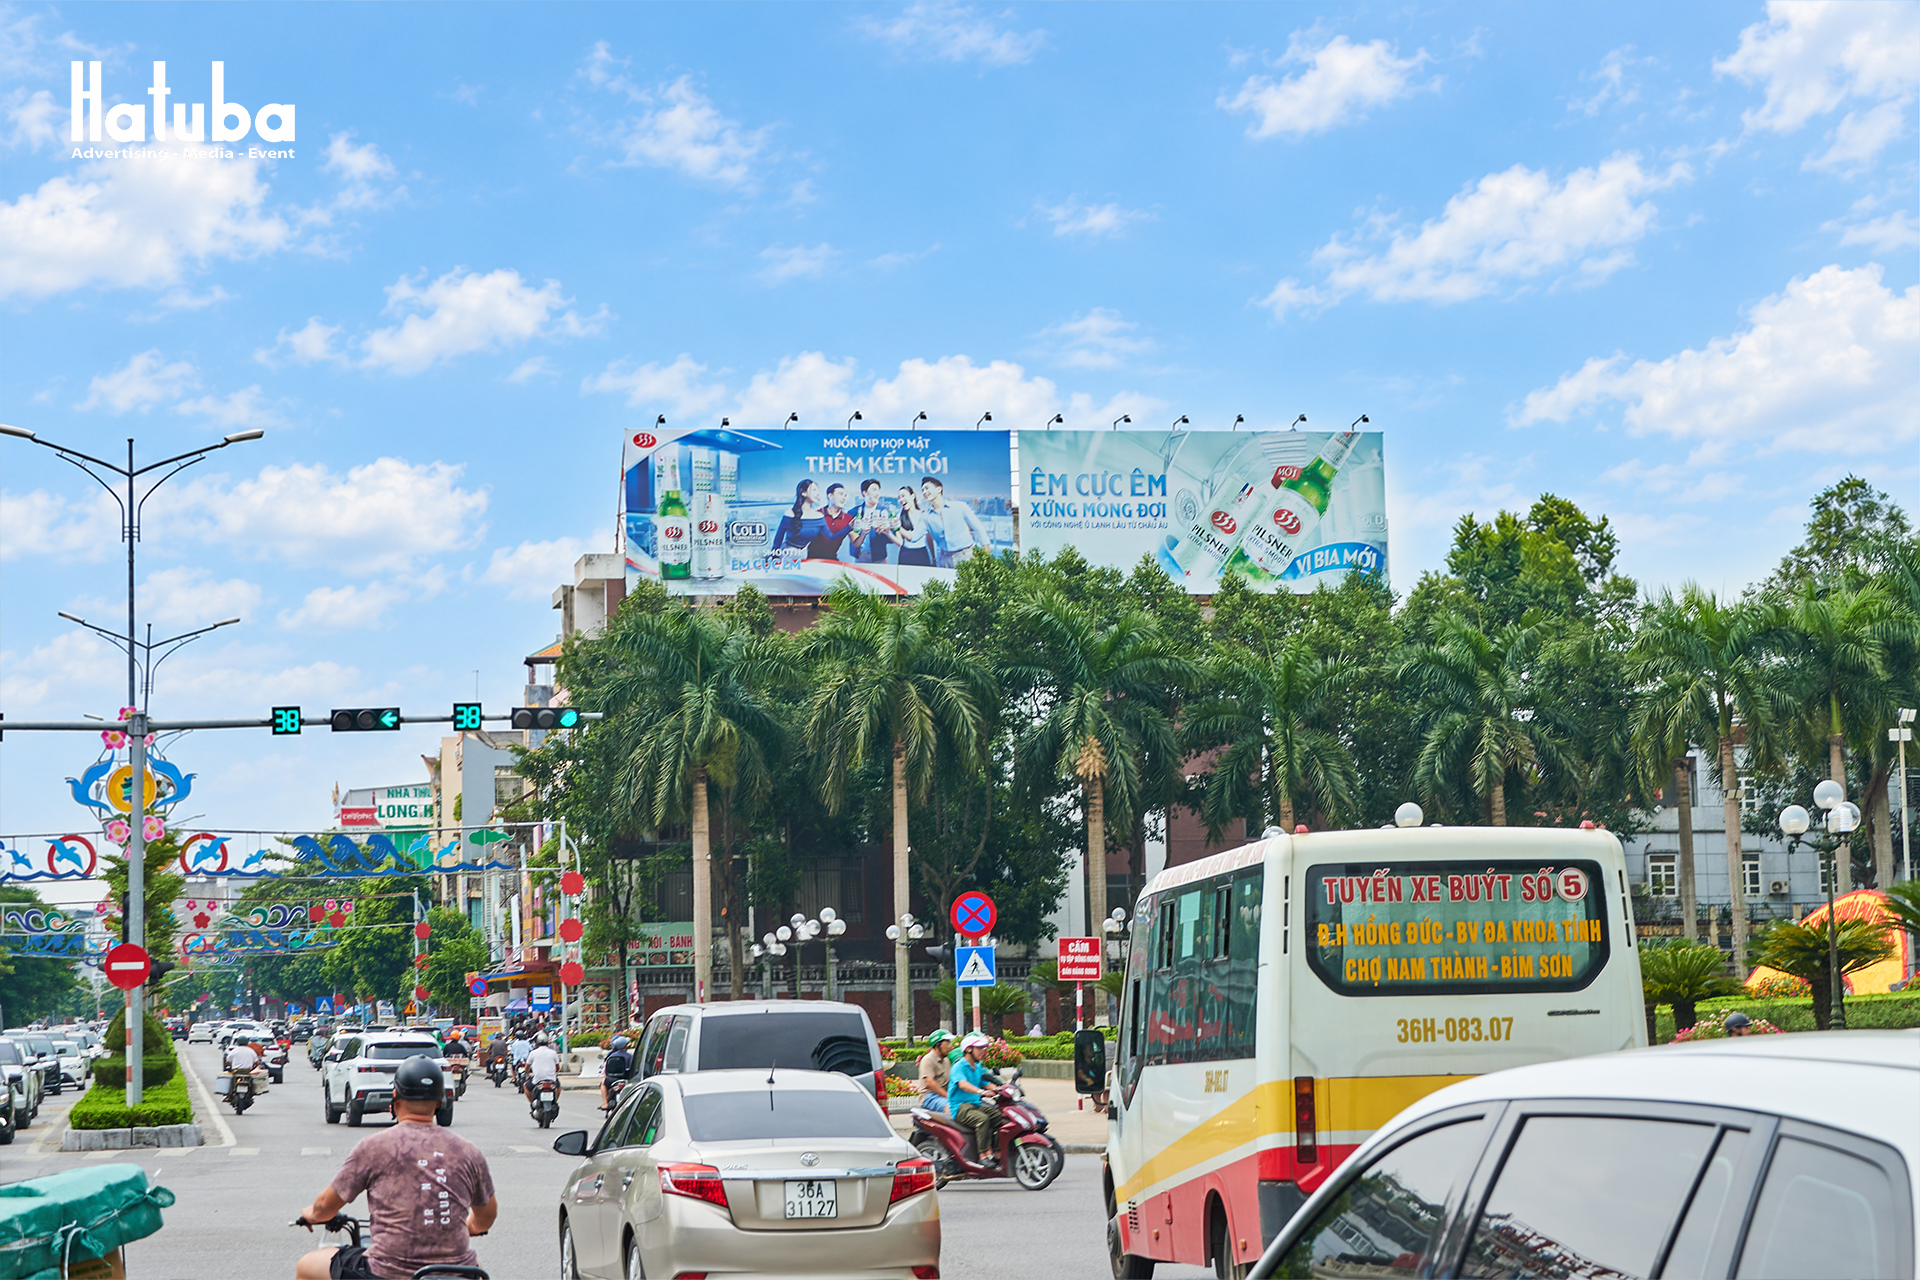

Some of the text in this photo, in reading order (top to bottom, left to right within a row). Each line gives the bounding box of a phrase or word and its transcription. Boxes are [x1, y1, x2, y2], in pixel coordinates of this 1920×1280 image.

[805, 450, 948, 474] THÊM KẾT NỐI
[1030, 466, 1167, 500] ÊM CỰC ÊM
[1030, 499, 1077, 517] XỨNG
[1136, 501, 1166, 521] ĐỢI
[733, 523, 766, 536] COLD
[1191, 524, 1230, 556] PILSNER
[1252, 524, 1293, 559] PILSNER
[1296, 545, 1377, 576] VỊ BIA MỚI
[274, 710, 299, 731] 38
[456, 706, 480, 728] 38
[378, 805, 418, 818] LONG
[1323, 867, 1581, 904] TUYẾN XE BUÝT SỐ 5
[670, 933, 693, 949] BÁNH
[1354, 913, 1400, 945] HỒNG
[1406, 917, 1443, 944] ĐỨC
[1457, 921, 1479, 943] BV
[1484, 920, 1507, 943] ĐA
[1512, 920, 1558, 943] KHOA
[1561, 913, 1602, 942] TỈNH
[1068, 940, 1090, 953] CẤM
[1345, 956, 1383, 986] CHỢ
[1387, 957, 1425, 980] NAM
[1430, 950, 1488, 979] THÀNH
[1501, 949, 1534, 978] BỈM
[1539, 952, 1572, 977] SƠN
[1397, 1017, 1514, 1043] 36H-083.07
[797, 1183, 824, 1199] 36A
[438, 1191, 451, 1225] CLUB
[787, 1200, 834, 1217] 311.27
